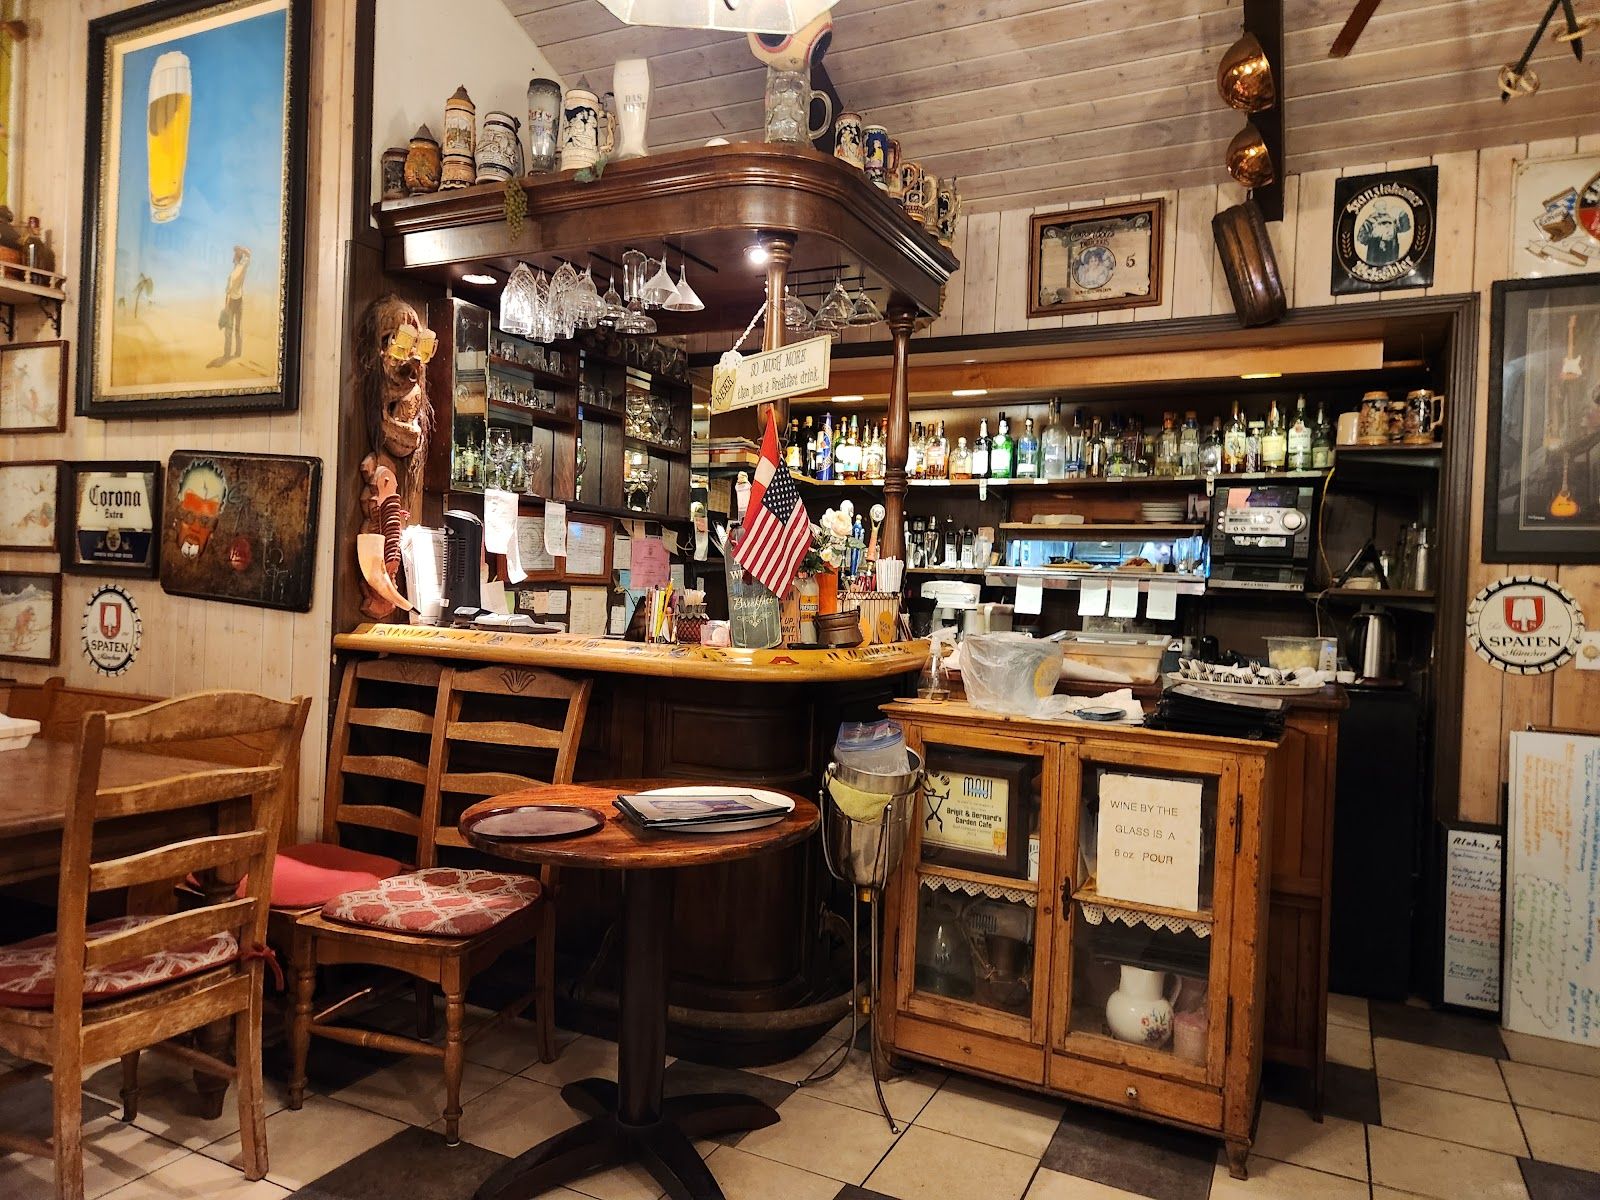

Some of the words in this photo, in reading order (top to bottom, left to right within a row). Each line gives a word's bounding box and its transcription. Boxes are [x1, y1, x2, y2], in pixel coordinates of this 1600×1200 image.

[762, 353, 782, 373] MUCH
[785, 348, 807, 367] MORE
[715, 375, 734, 405] BEER
[89, 484, 141, 512] Corona
[104, 508, 124, 519] Extra
[91, 640, 128, 653] SPATEN
[1489, 636, 1562, 648] SPATEN
[1110, 800, 1138, 812] WINE
[1140, 803, 1155, 813] BY
[1157, 805, 1178, 816] THE
[955, 817, 977, 826] Garden
[972, 811, 1002, 822] Bernard's
[1115, 824, 1150, 838] GLASS
[1153, 829, 1163, 838] IS
[1168, 832, 1176, 841] A
[1122, 851, 1135, 859] oz
[1142, 852, 1173, 865] POUR
